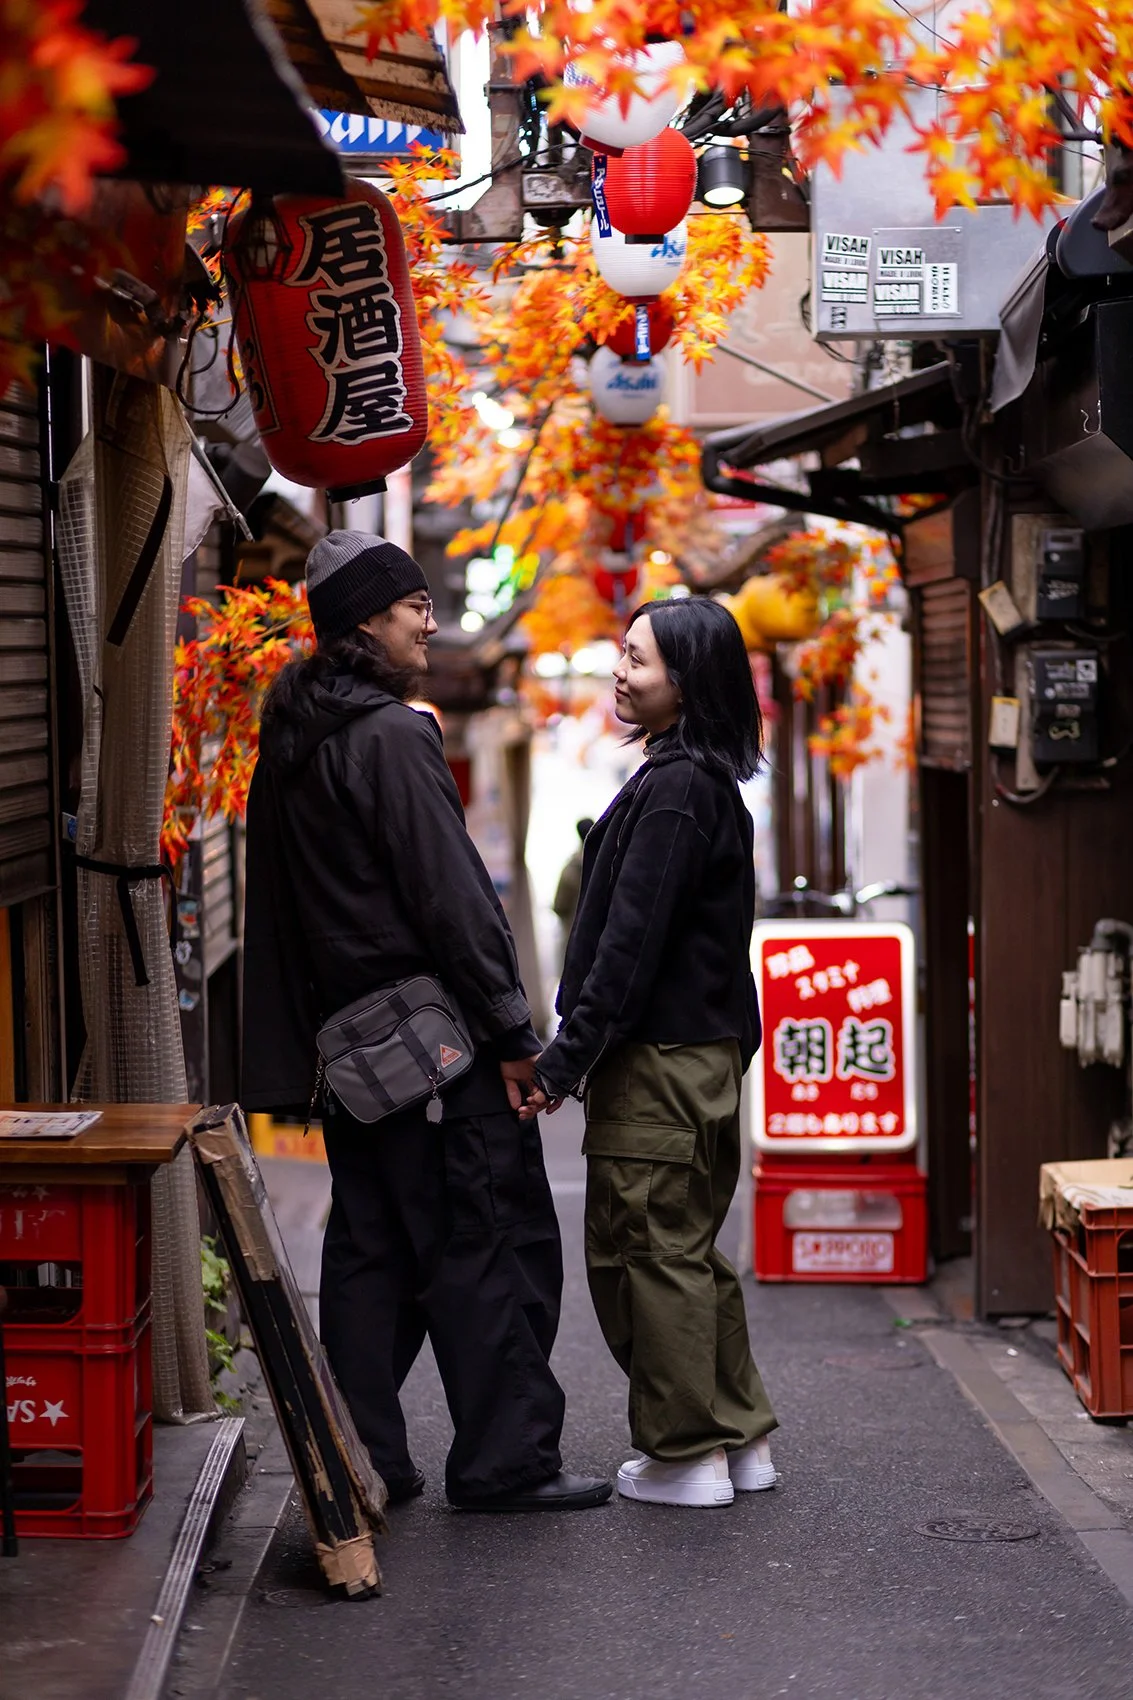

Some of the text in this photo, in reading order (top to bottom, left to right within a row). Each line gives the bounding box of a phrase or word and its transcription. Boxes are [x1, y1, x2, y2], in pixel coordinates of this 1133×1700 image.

[593, 168, 611, 231] アサヒビール
[827, 235, 868, 254] VISAH
[880, 249, 922, 265] VISAH
[284, 200, 414, 446] 居酒屋
